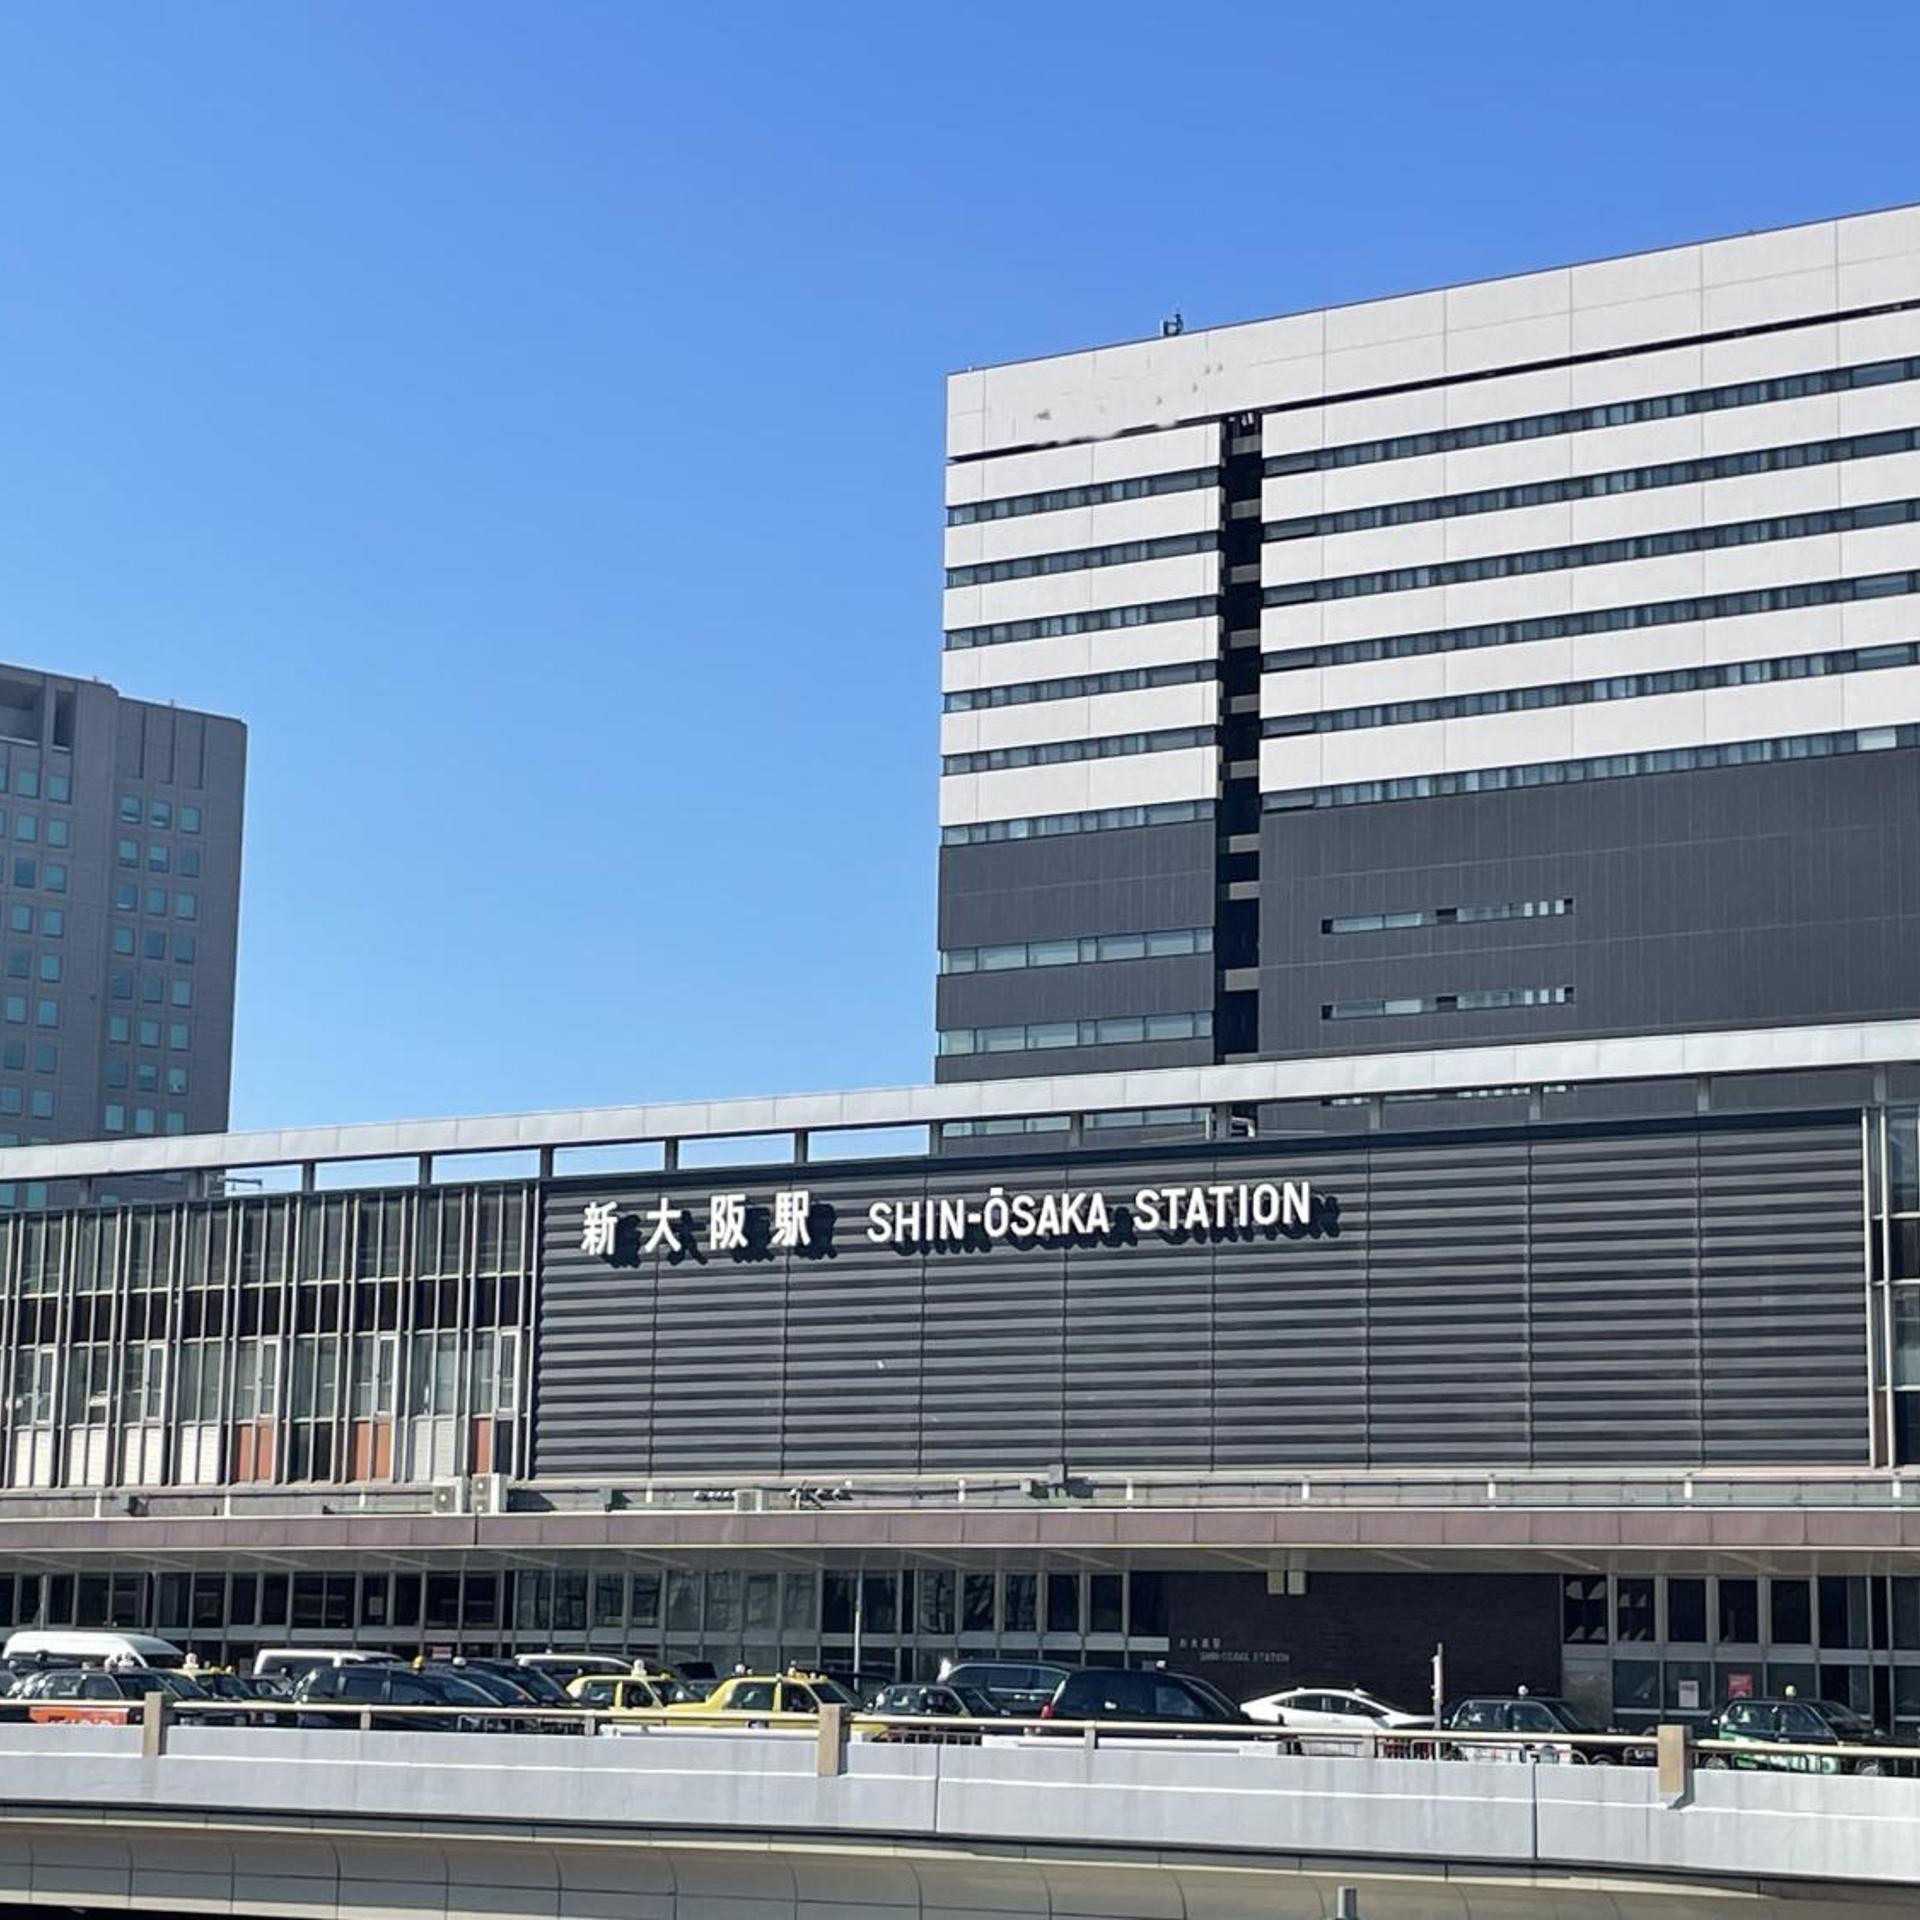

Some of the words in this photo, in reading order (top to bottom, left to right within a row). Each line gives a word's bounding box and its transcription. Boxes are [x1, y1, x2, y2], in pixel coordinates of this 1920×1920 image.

[580, 1190, 811, 1255] 新大阪駅
[867, 1187, 1111, 1242] SHIN-ŌSAKA
[1133, 1181, 1311, 1232] STATION
